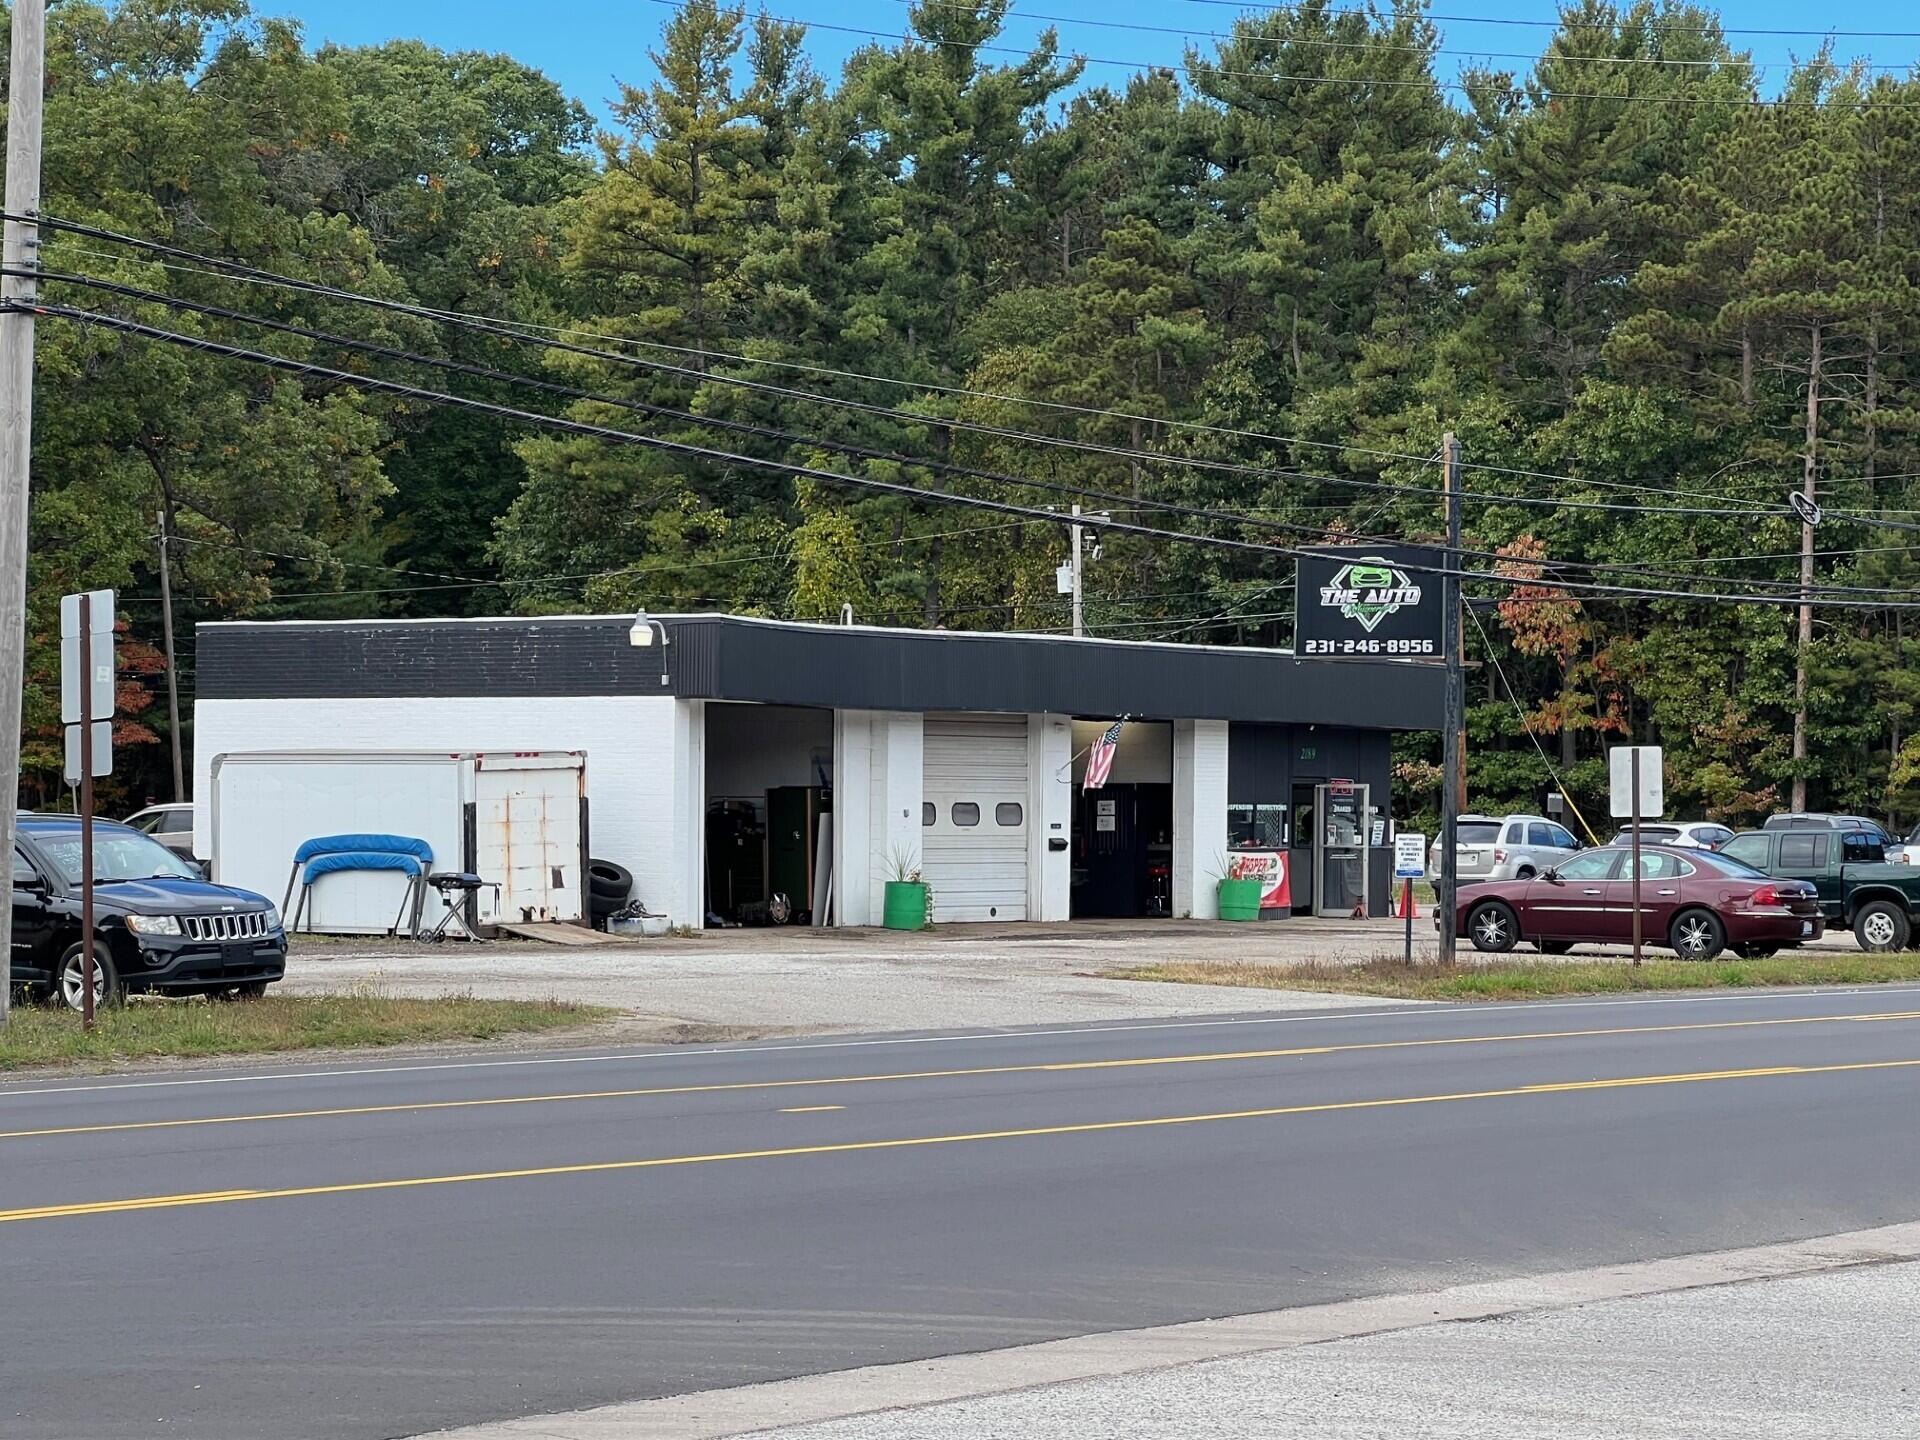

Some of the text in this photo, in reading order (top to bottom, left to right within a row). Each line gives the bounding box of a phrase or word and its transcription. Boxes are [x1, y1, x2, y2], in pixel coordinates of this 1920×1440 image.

[1321, 589, 1419, 603] THE AUTO
[1305, 639, 1433, 653] 231-246-8956
